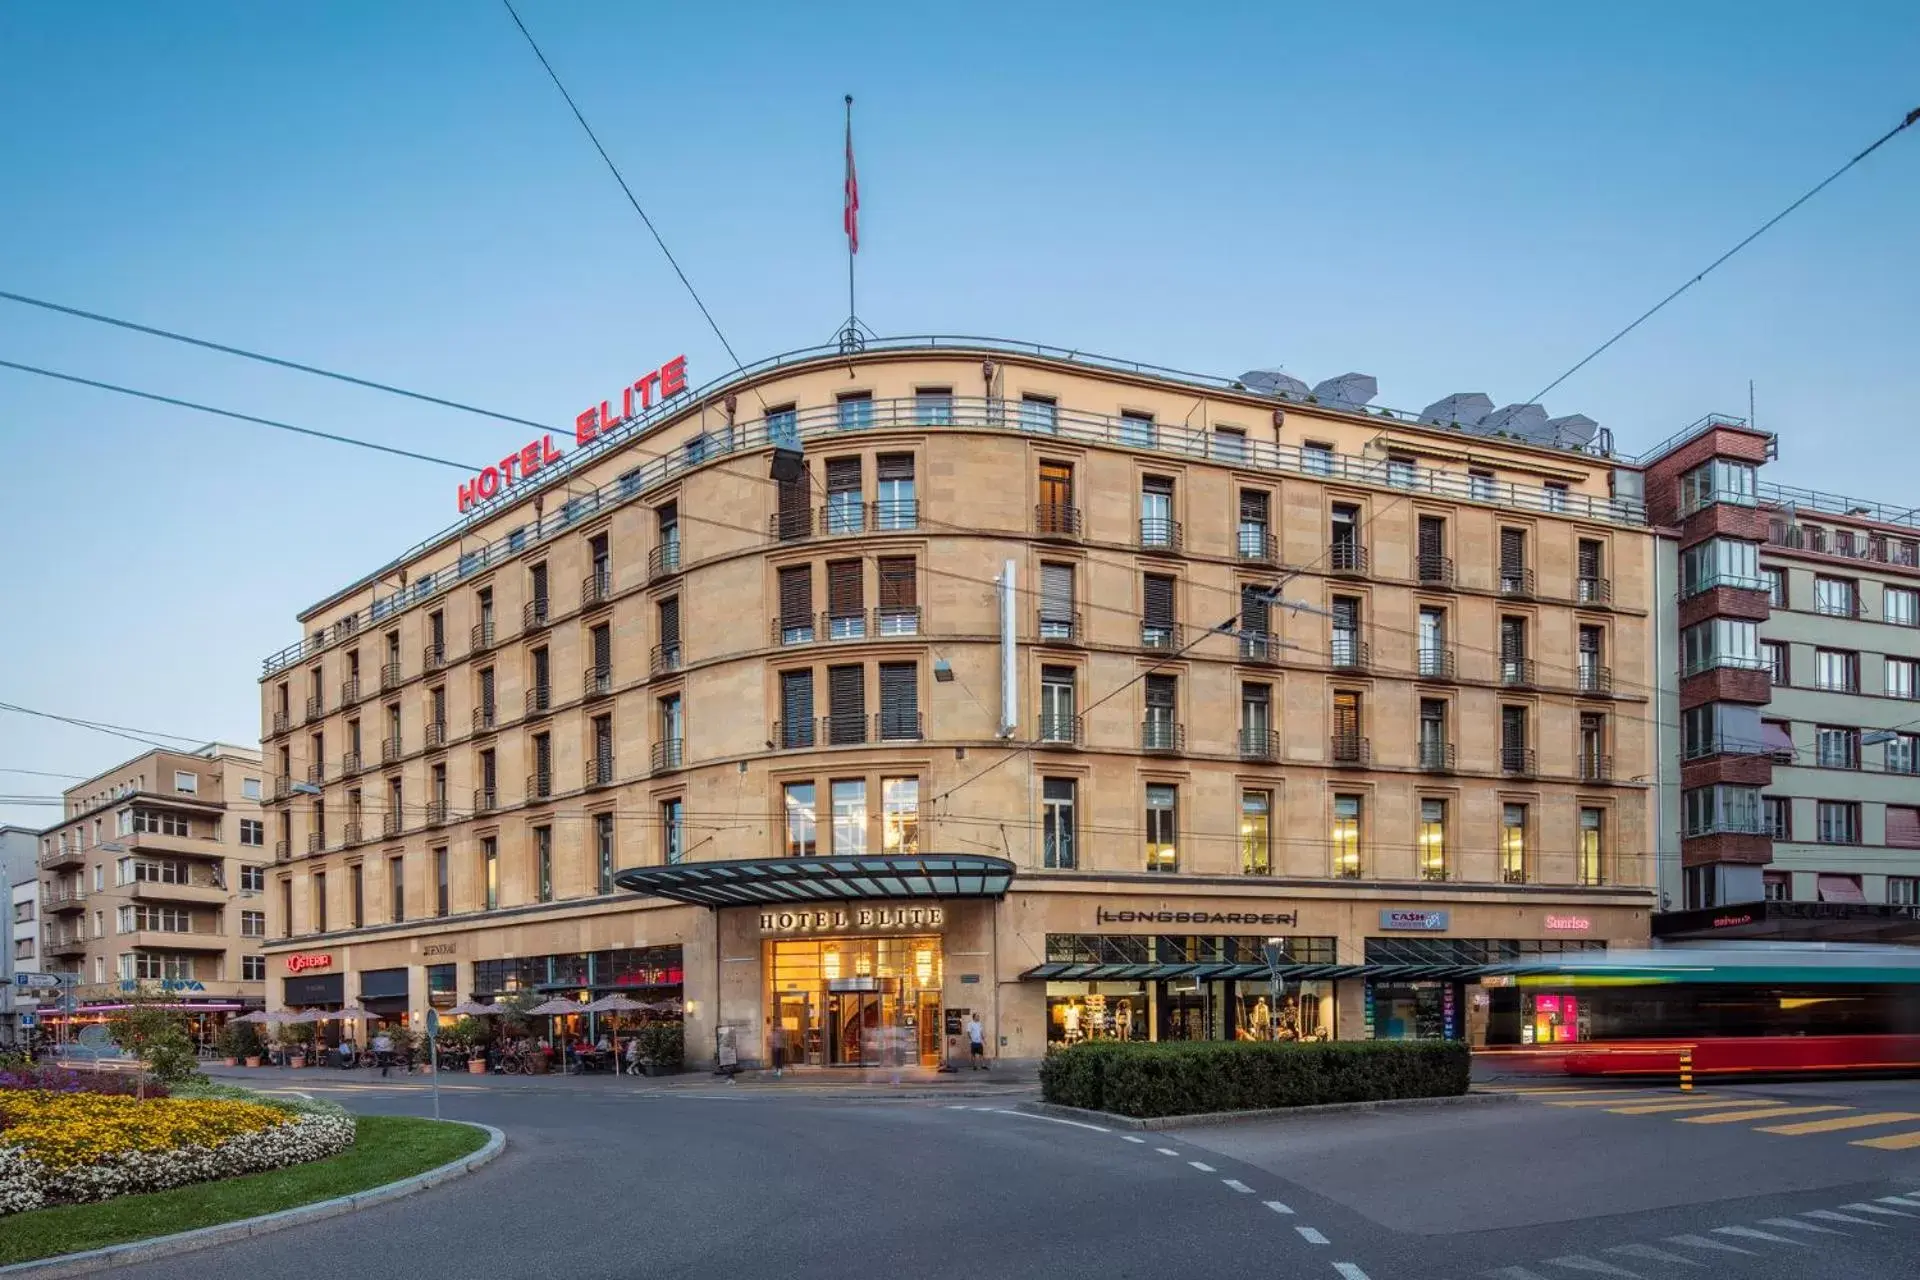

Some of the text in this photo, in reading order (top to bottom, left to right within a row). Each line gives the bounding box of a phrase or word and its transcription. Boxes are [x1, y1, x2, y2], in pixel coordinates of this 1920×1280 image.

[457, 354, 688, 513] HOTEL ELITE
[760, 909, 942, 929] HOTEL ELITE
[1101, 909, 1292, 926] LONGBOARDER
[1546, 914, 1589, 930] Sunrise
